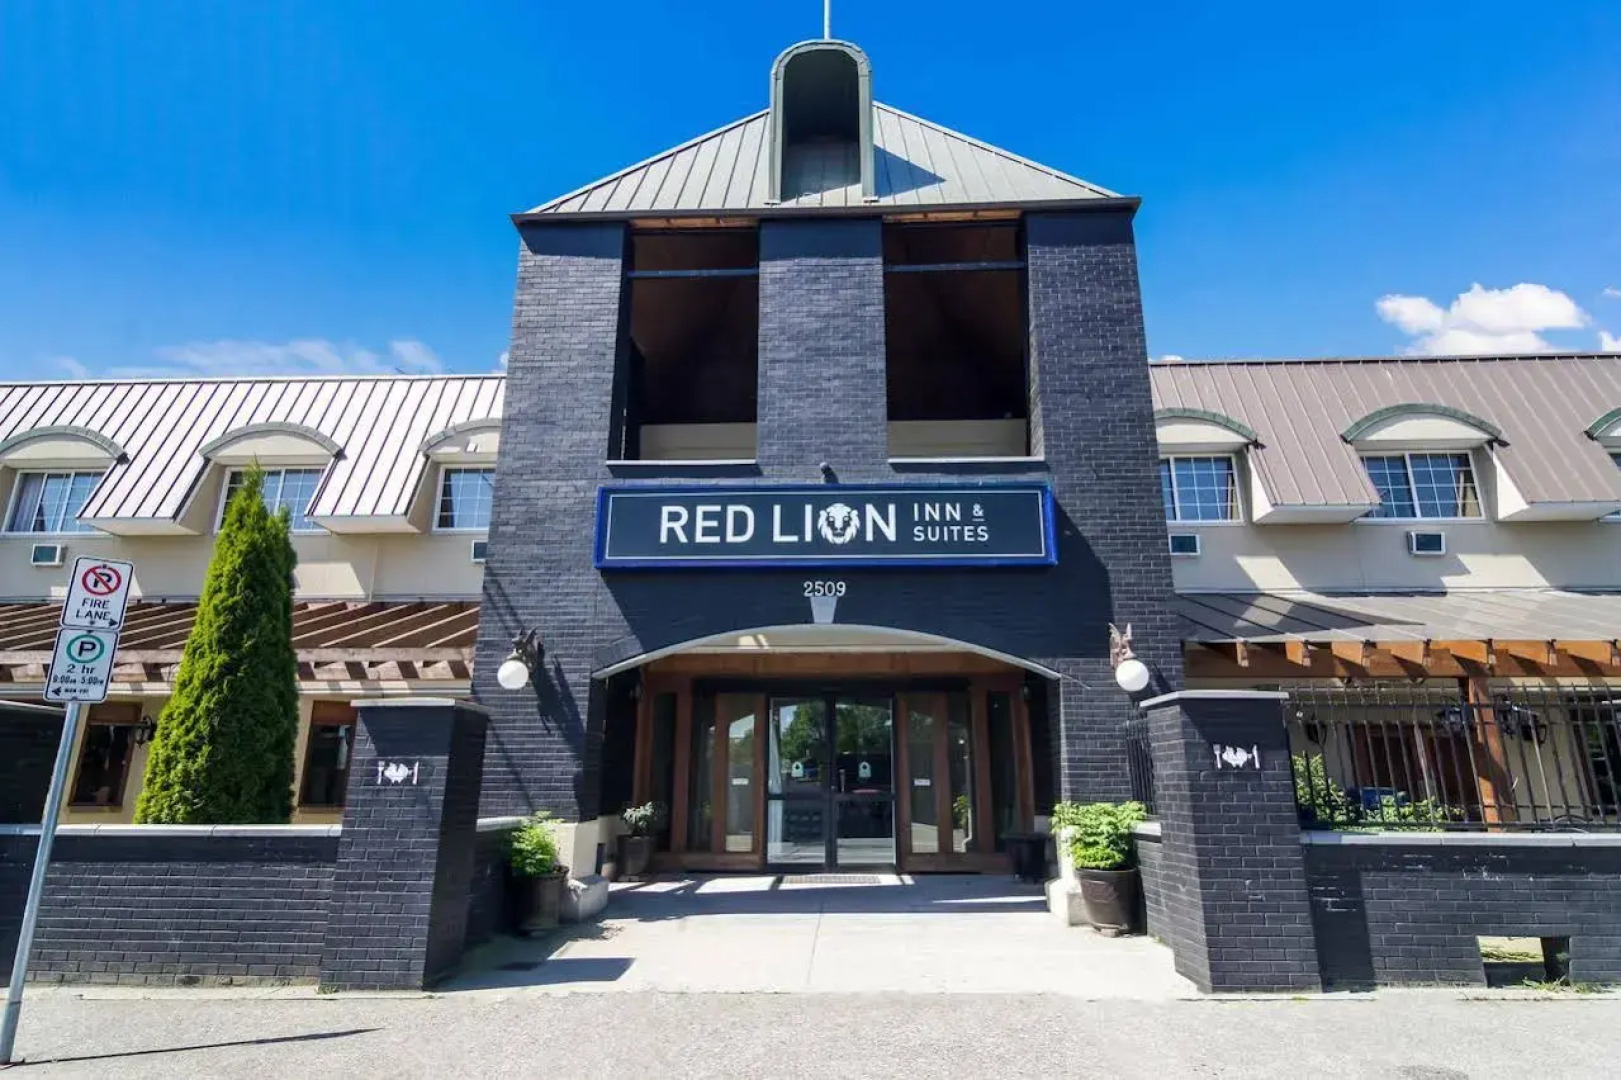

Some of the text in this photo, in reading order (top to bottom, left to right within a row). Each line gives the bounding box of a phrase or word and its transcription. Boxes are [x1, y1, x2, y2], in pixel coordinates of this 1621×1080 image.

[913, 502, 985, 522] INN &
[659, 504, 755, 543] RED
[913, 525, 989, 541] SUITES
[803, 581, 846, 597] 2509
[81, 597, 110, 609] FIRE
[76, 608, 110, 620] LANE
[78, 640, 97, 657] P
[67, 663, 95, 674] 2 hr
